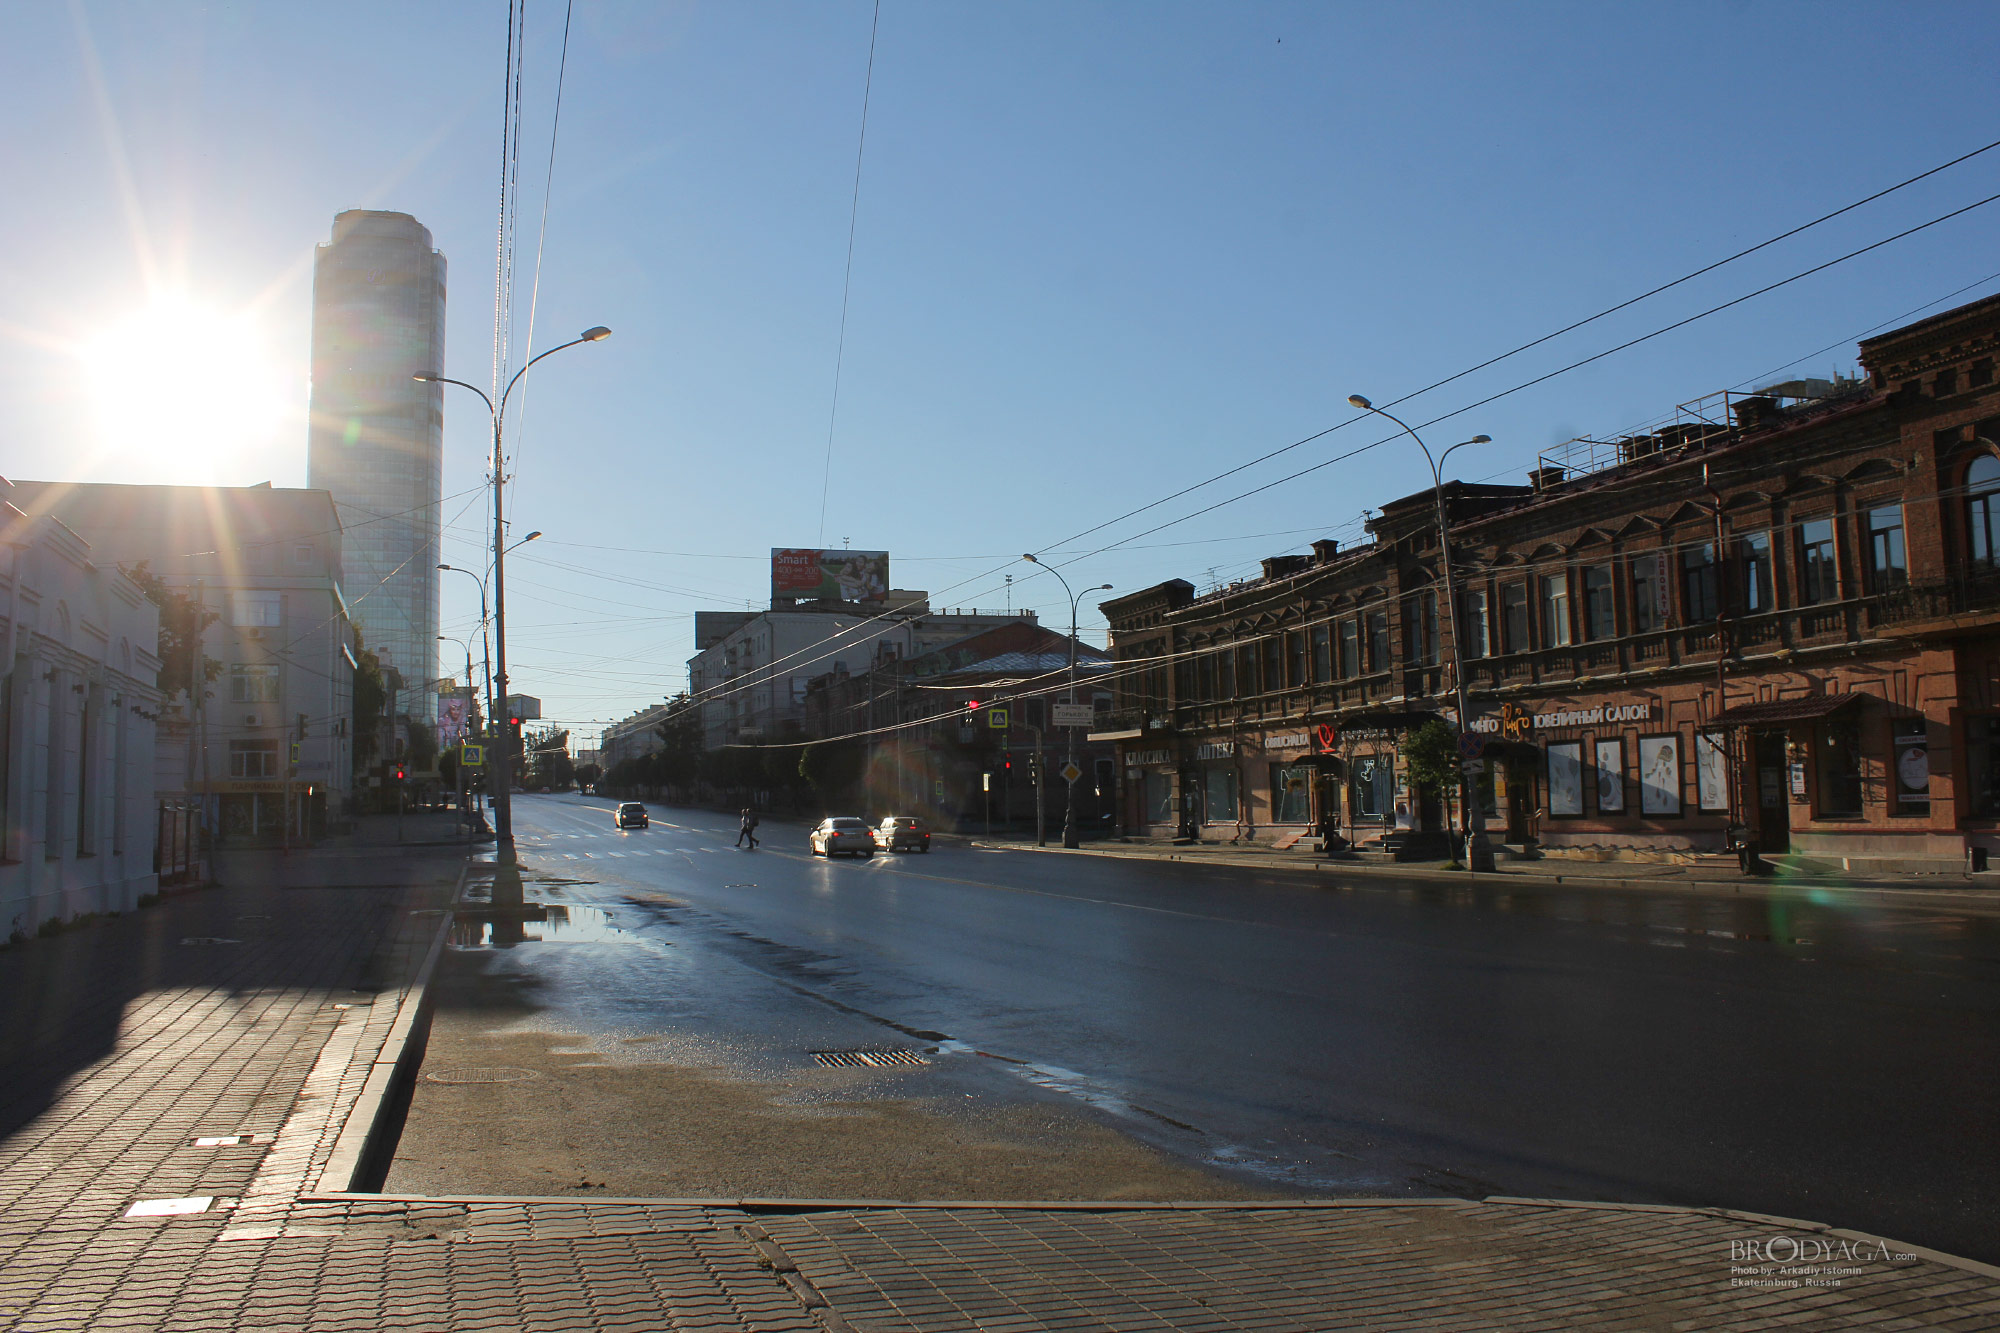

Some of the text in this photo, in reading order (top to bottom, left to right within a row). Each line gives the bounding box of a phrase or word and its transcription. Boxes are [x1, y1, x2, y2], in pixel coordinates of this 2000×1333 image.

[777, 554, 808, 565] Smart
[1658, 551, 1669, 616] АДВОКАТЫ
[1533, 706, 1604, 729] ЮВЕЛИРНЫЙ
[1605, 704, 1650, 722] САЛОН
[1125, 749, 1171, 766] КЛАССИКА
[1196, 742, 1235, 761] АПТЕКА
